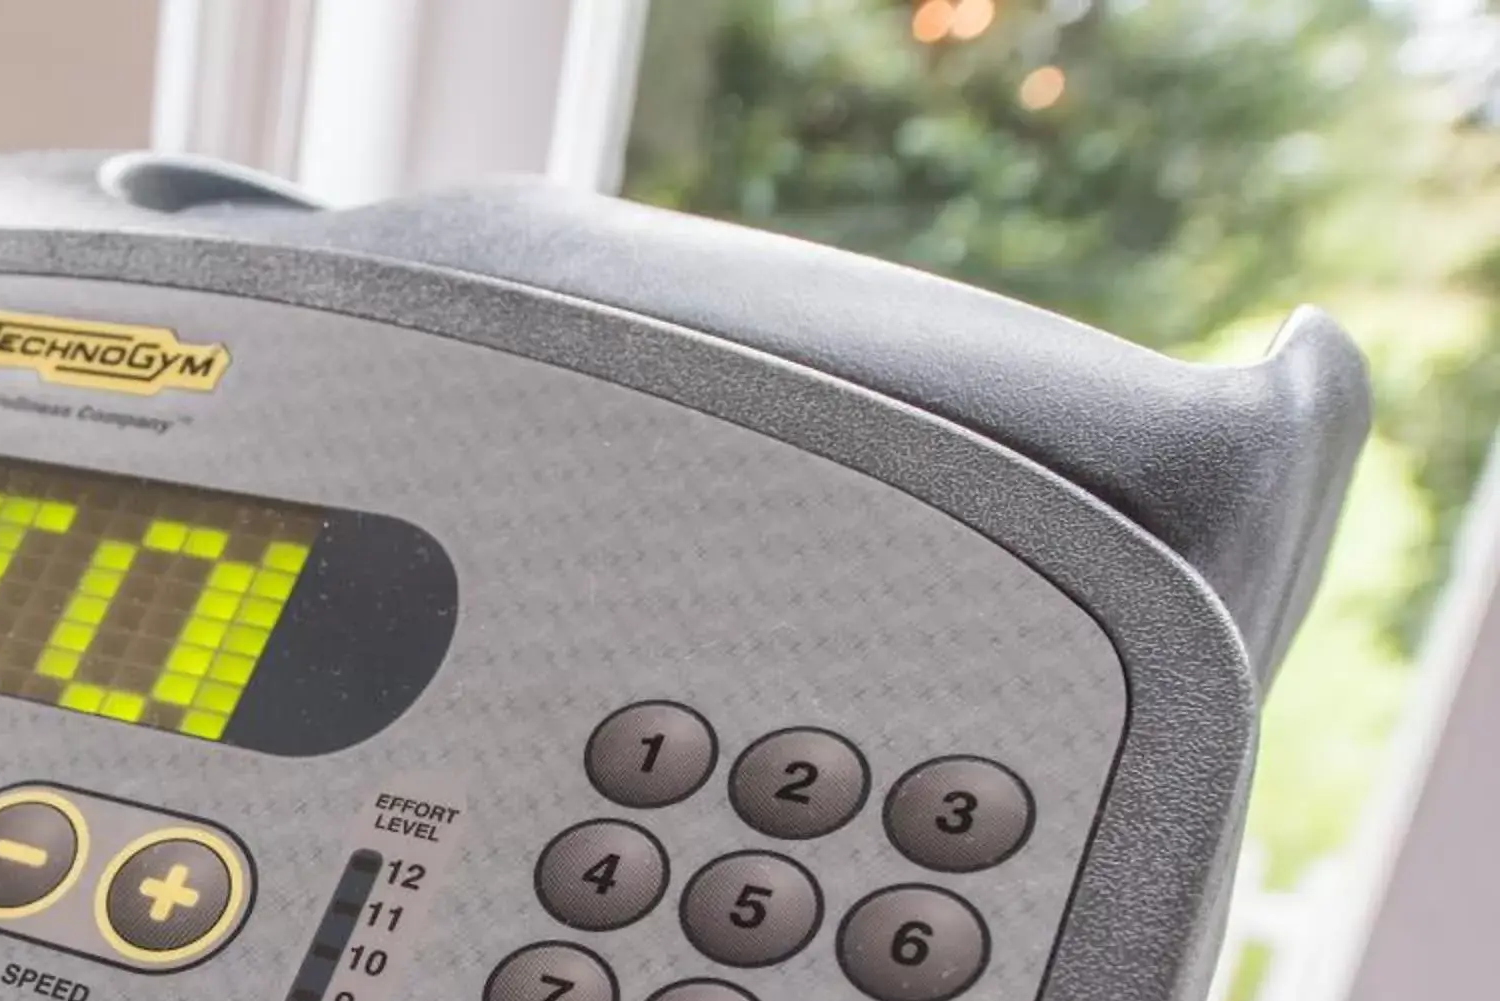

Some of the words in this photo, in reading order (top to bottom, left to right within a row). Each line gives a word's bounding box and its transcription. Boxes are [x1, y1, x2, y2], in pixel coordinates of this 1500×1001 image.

[639, 732, 665, 772] 1
[774, 761, 819, 804] 2
[374, 814, 439, 842] LEVEL
[375, 793, 460, 824] EFFORT
[935, 791, 978, 834] 3
[388, 859, 426, 890] 12
[582, 854, 620, 894] 4
[368, 902, 403, 931] 11
[729, 884, 772, 928] 5
[348, 944, 388, 977] 10
[890, 921, 933, 965] 6
